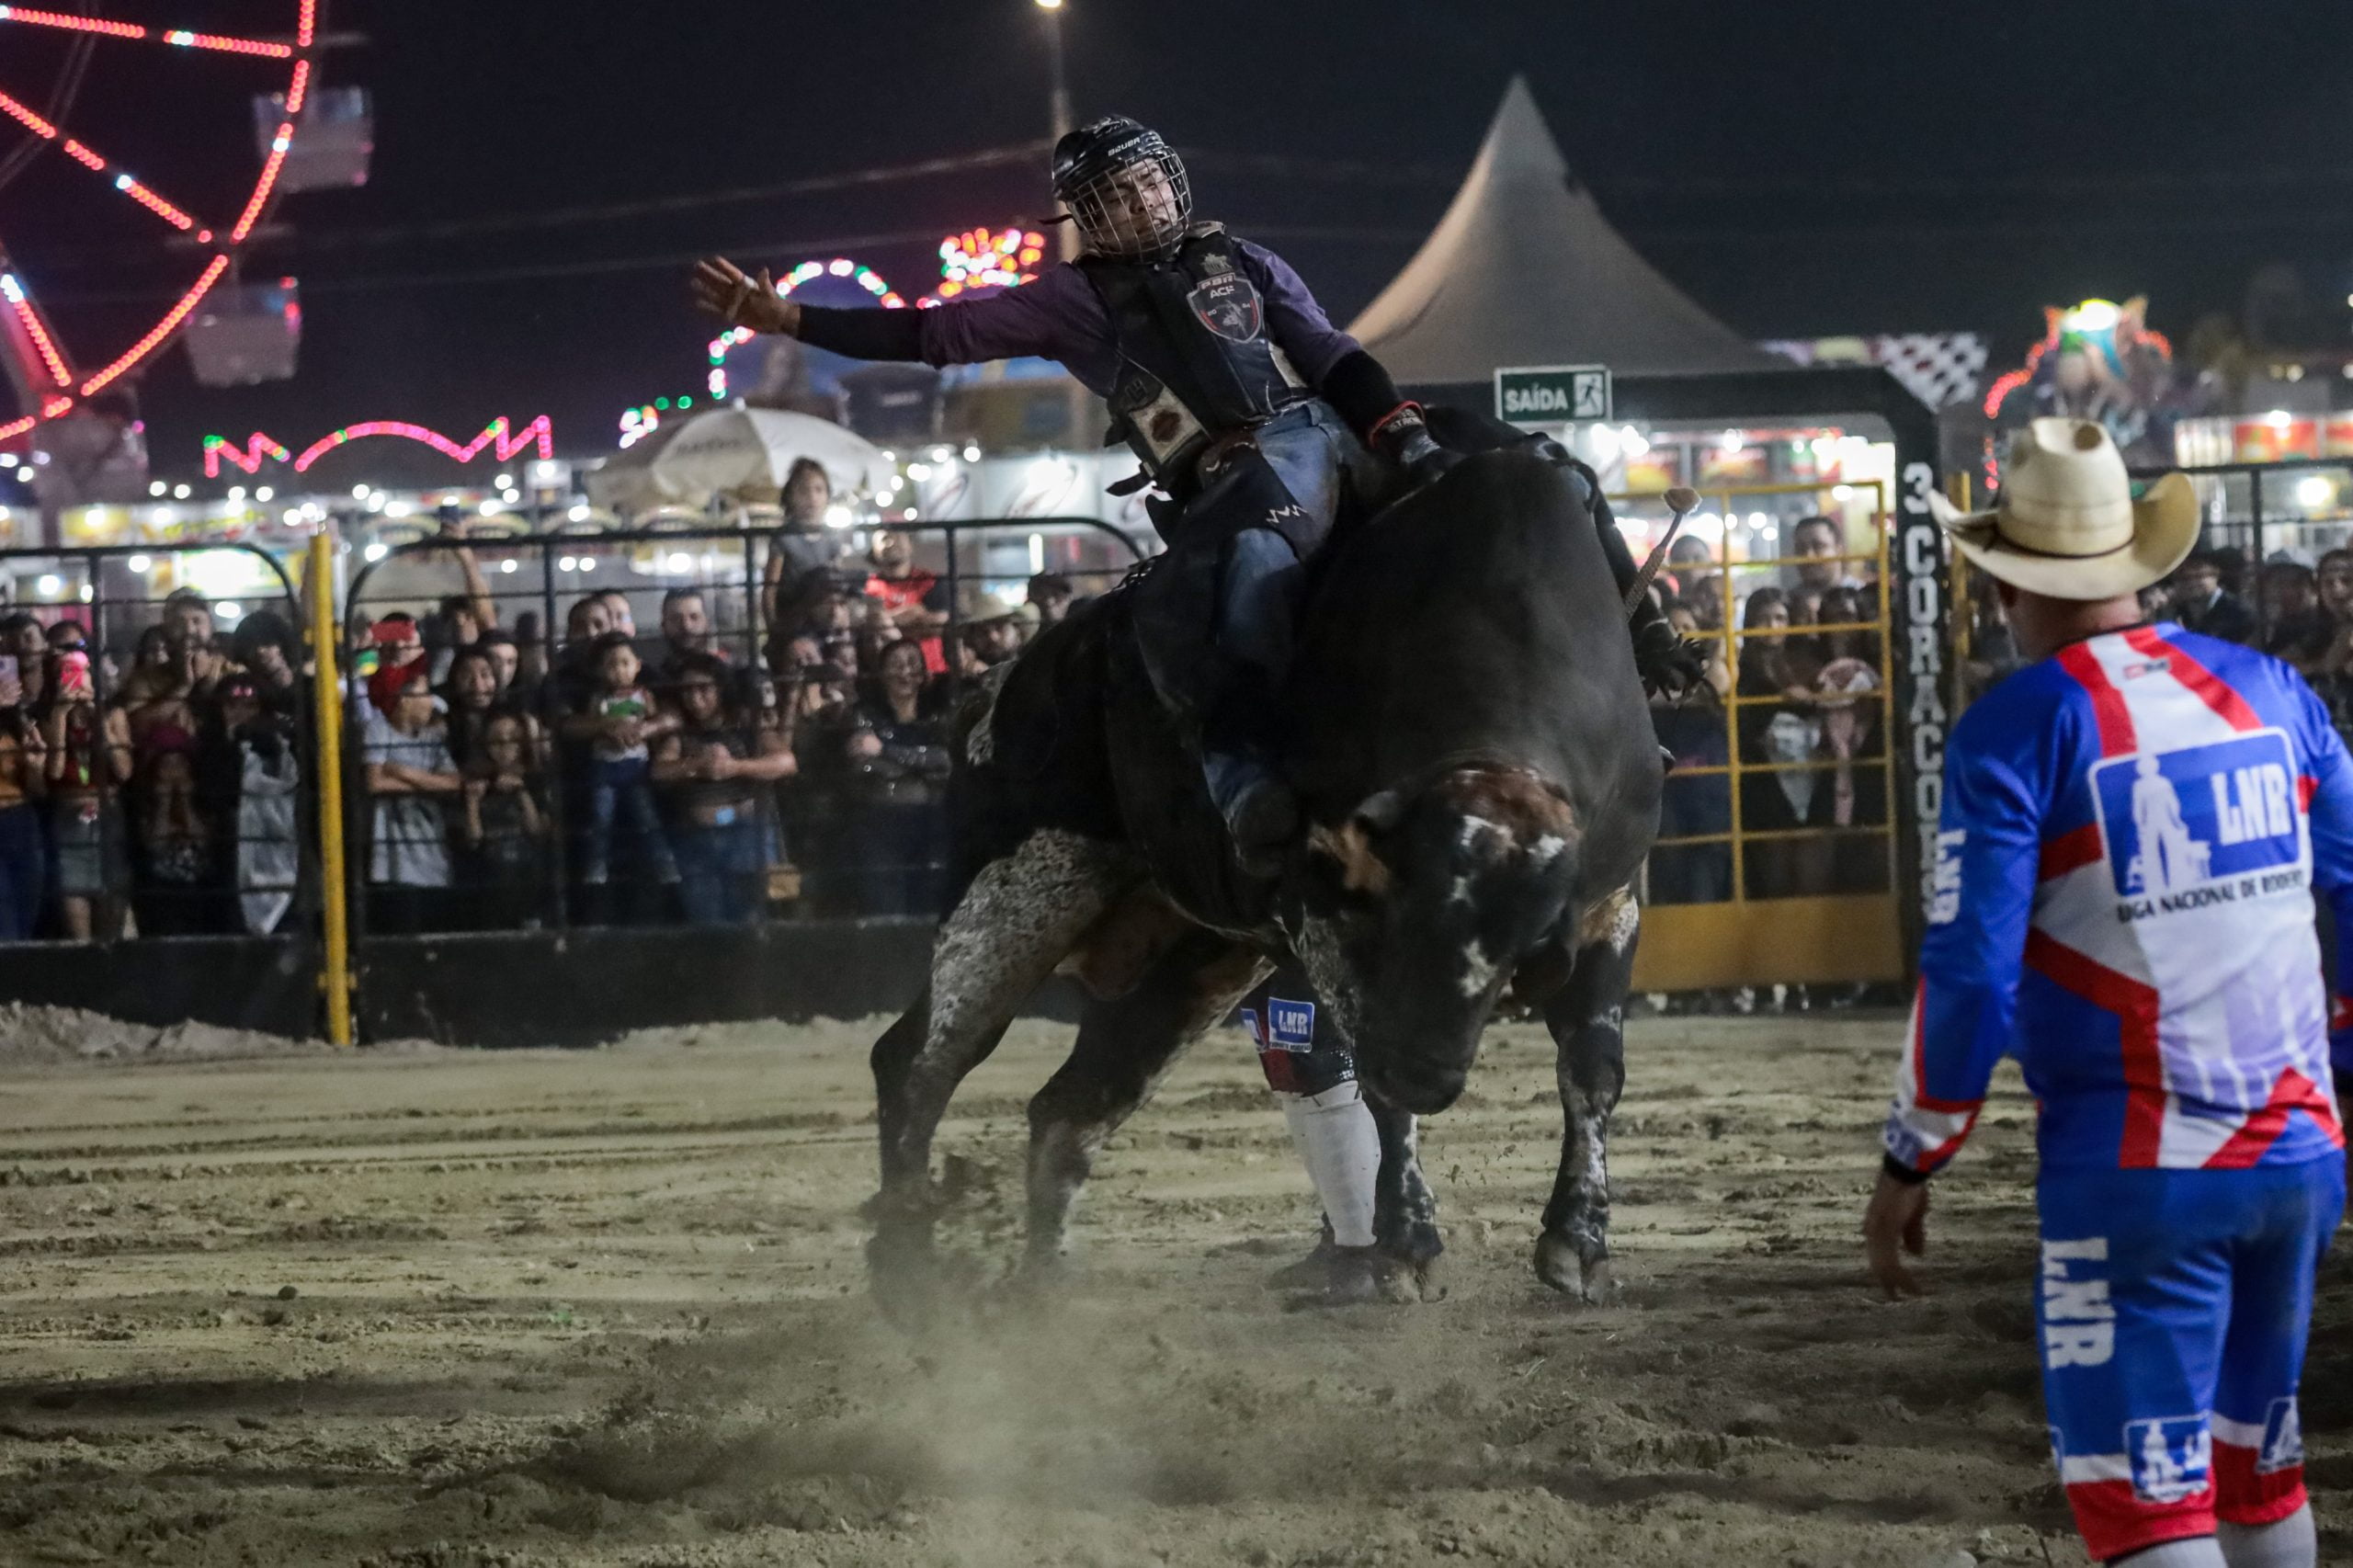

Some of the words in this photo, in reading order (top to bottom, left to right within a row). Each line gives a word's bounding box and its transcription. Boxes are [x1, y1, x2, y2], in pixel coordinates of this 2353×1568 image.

[1505, 382, 1569, 413] SAÍDA
[1903, 461, 1934, 515] 3
[2211, 763, 2293, 846] LNR
[1931, 829, 1966, 925] LNR
[2160, 881, 2235, 914] NACIONAL
[1279, 1010, 1309, 1035] LNR
[2041, 1236, 2118, 1371] LNR
